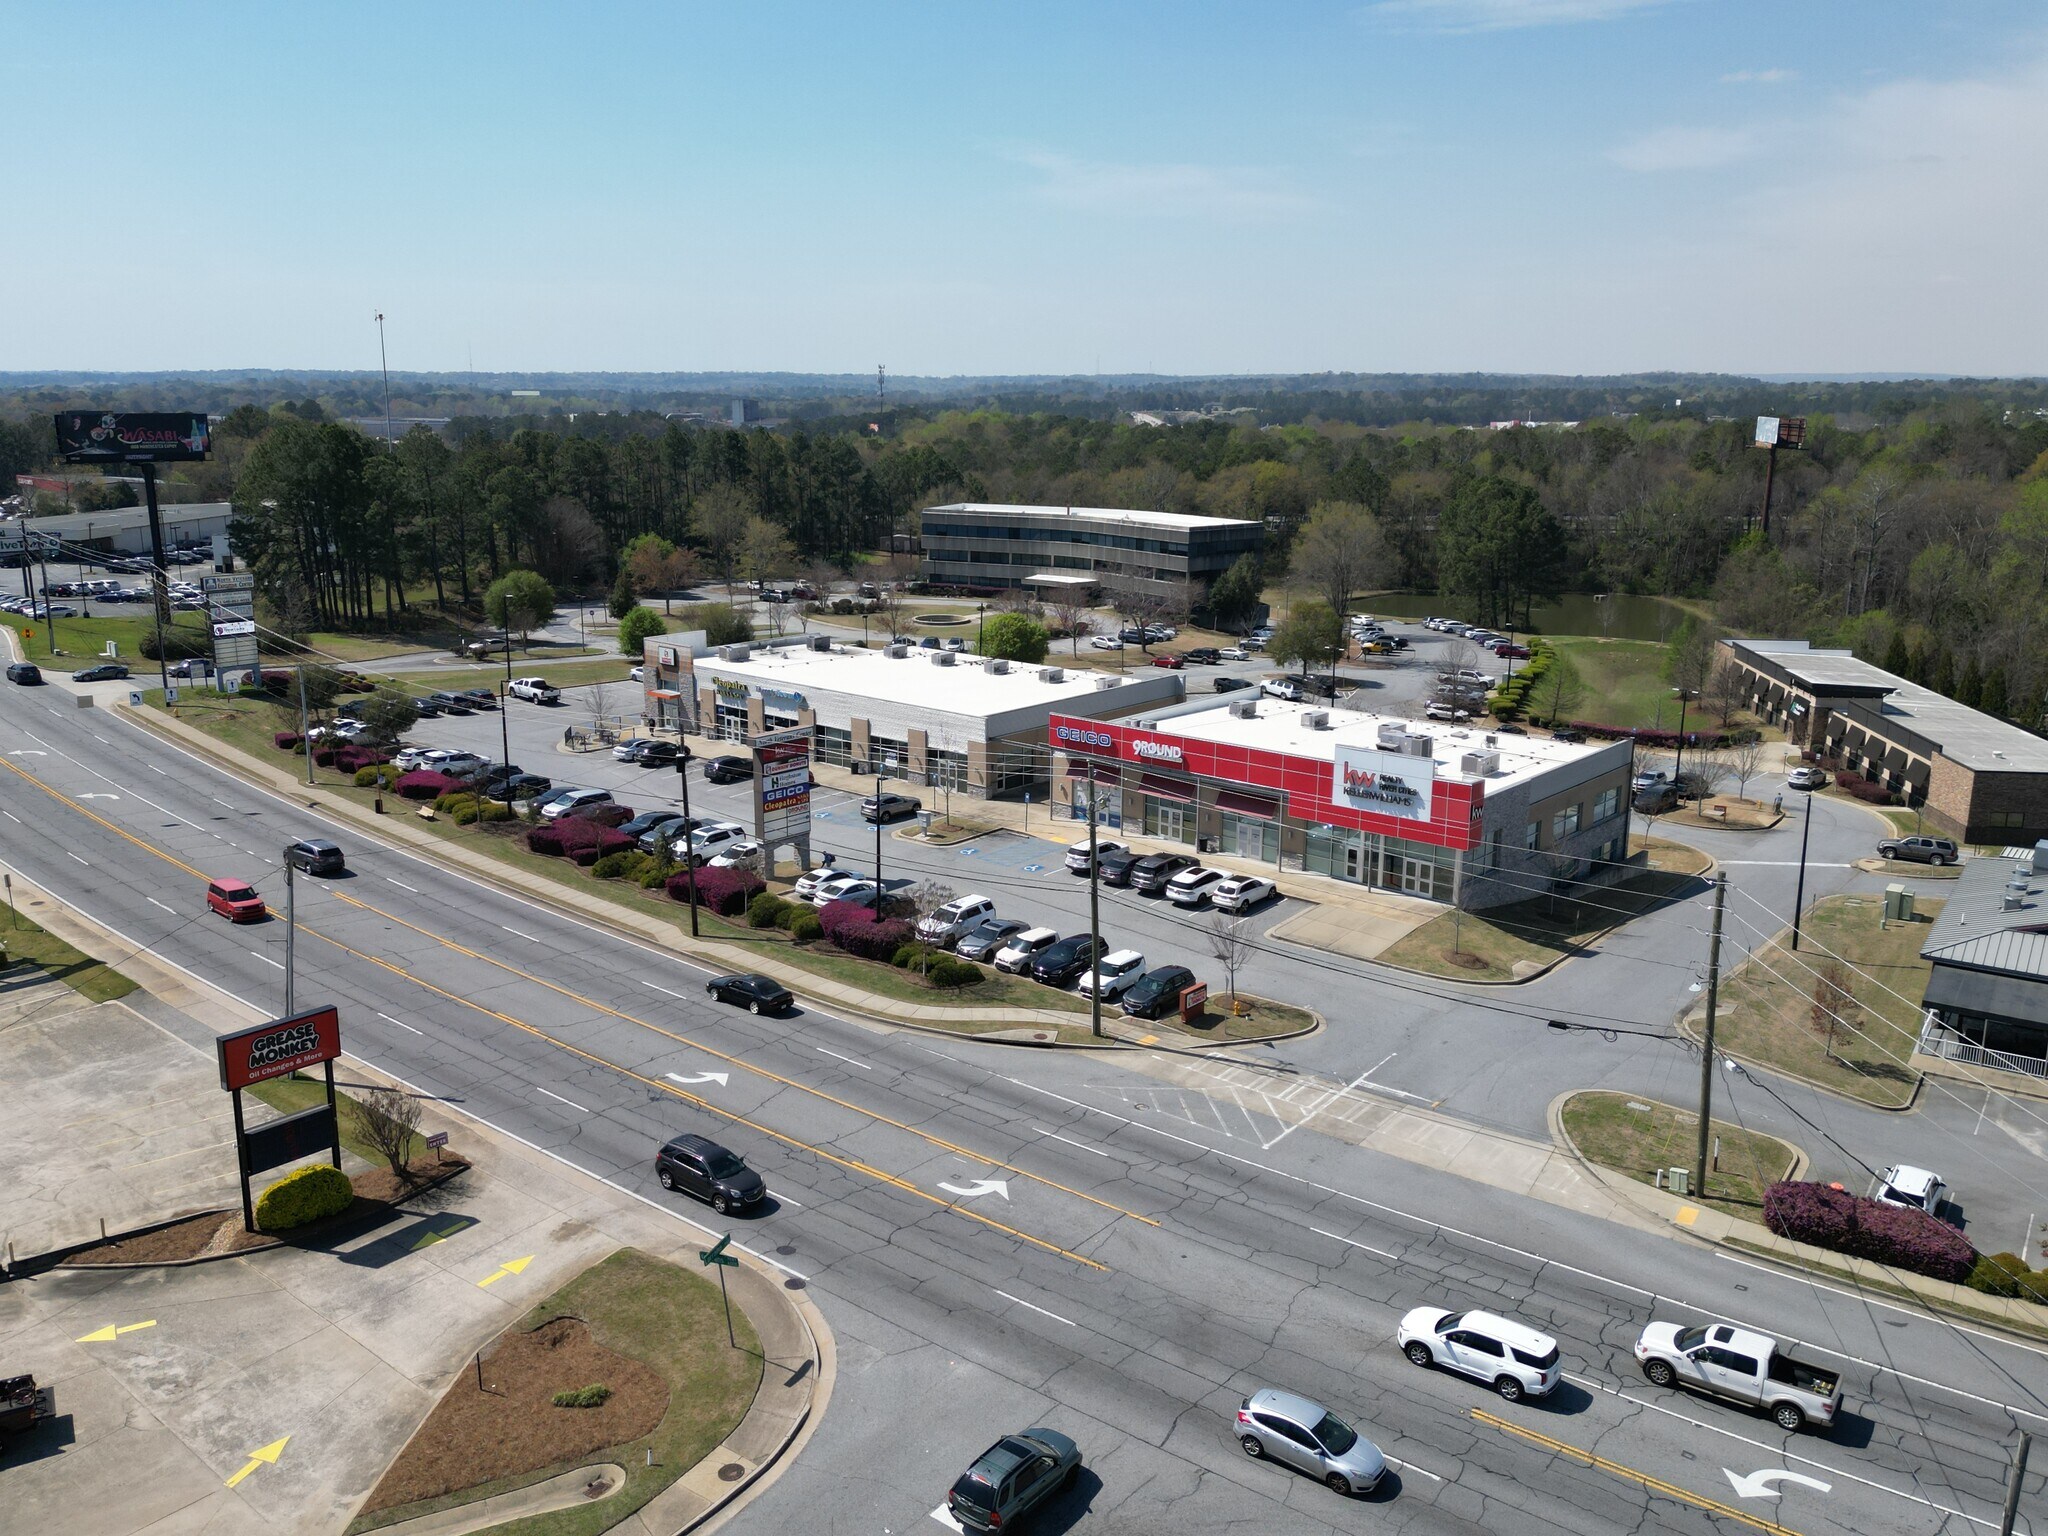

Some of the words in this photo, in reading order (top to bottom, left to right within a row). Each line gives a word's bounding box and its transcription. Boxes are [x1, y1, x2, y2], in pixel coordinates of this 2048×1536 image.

[117, 427, 177, 443] WASABI
[1057, 726, 1112, 747] GEICO
[1132, 740, 1181, 758] 9ROUND
[1343, 761, 1376, 788] kw
[1380, 774, 1403, 784] REALTY
[767, 785, 804, 800] GEICO
[1379, 784, 1397, 793] RIVER
[1398, 787, 1417, 796] CITIES
[764, 797, 797, 810] Cleopatra
[252, 1023, 315, 1052] GREASE
[248, 1034, 320, 1069] MONKEY
[249, 1071, 260, 1079] Oil
[261, 1062, 295, 1075] Changes
[304, 1052, 323, 1062] More
